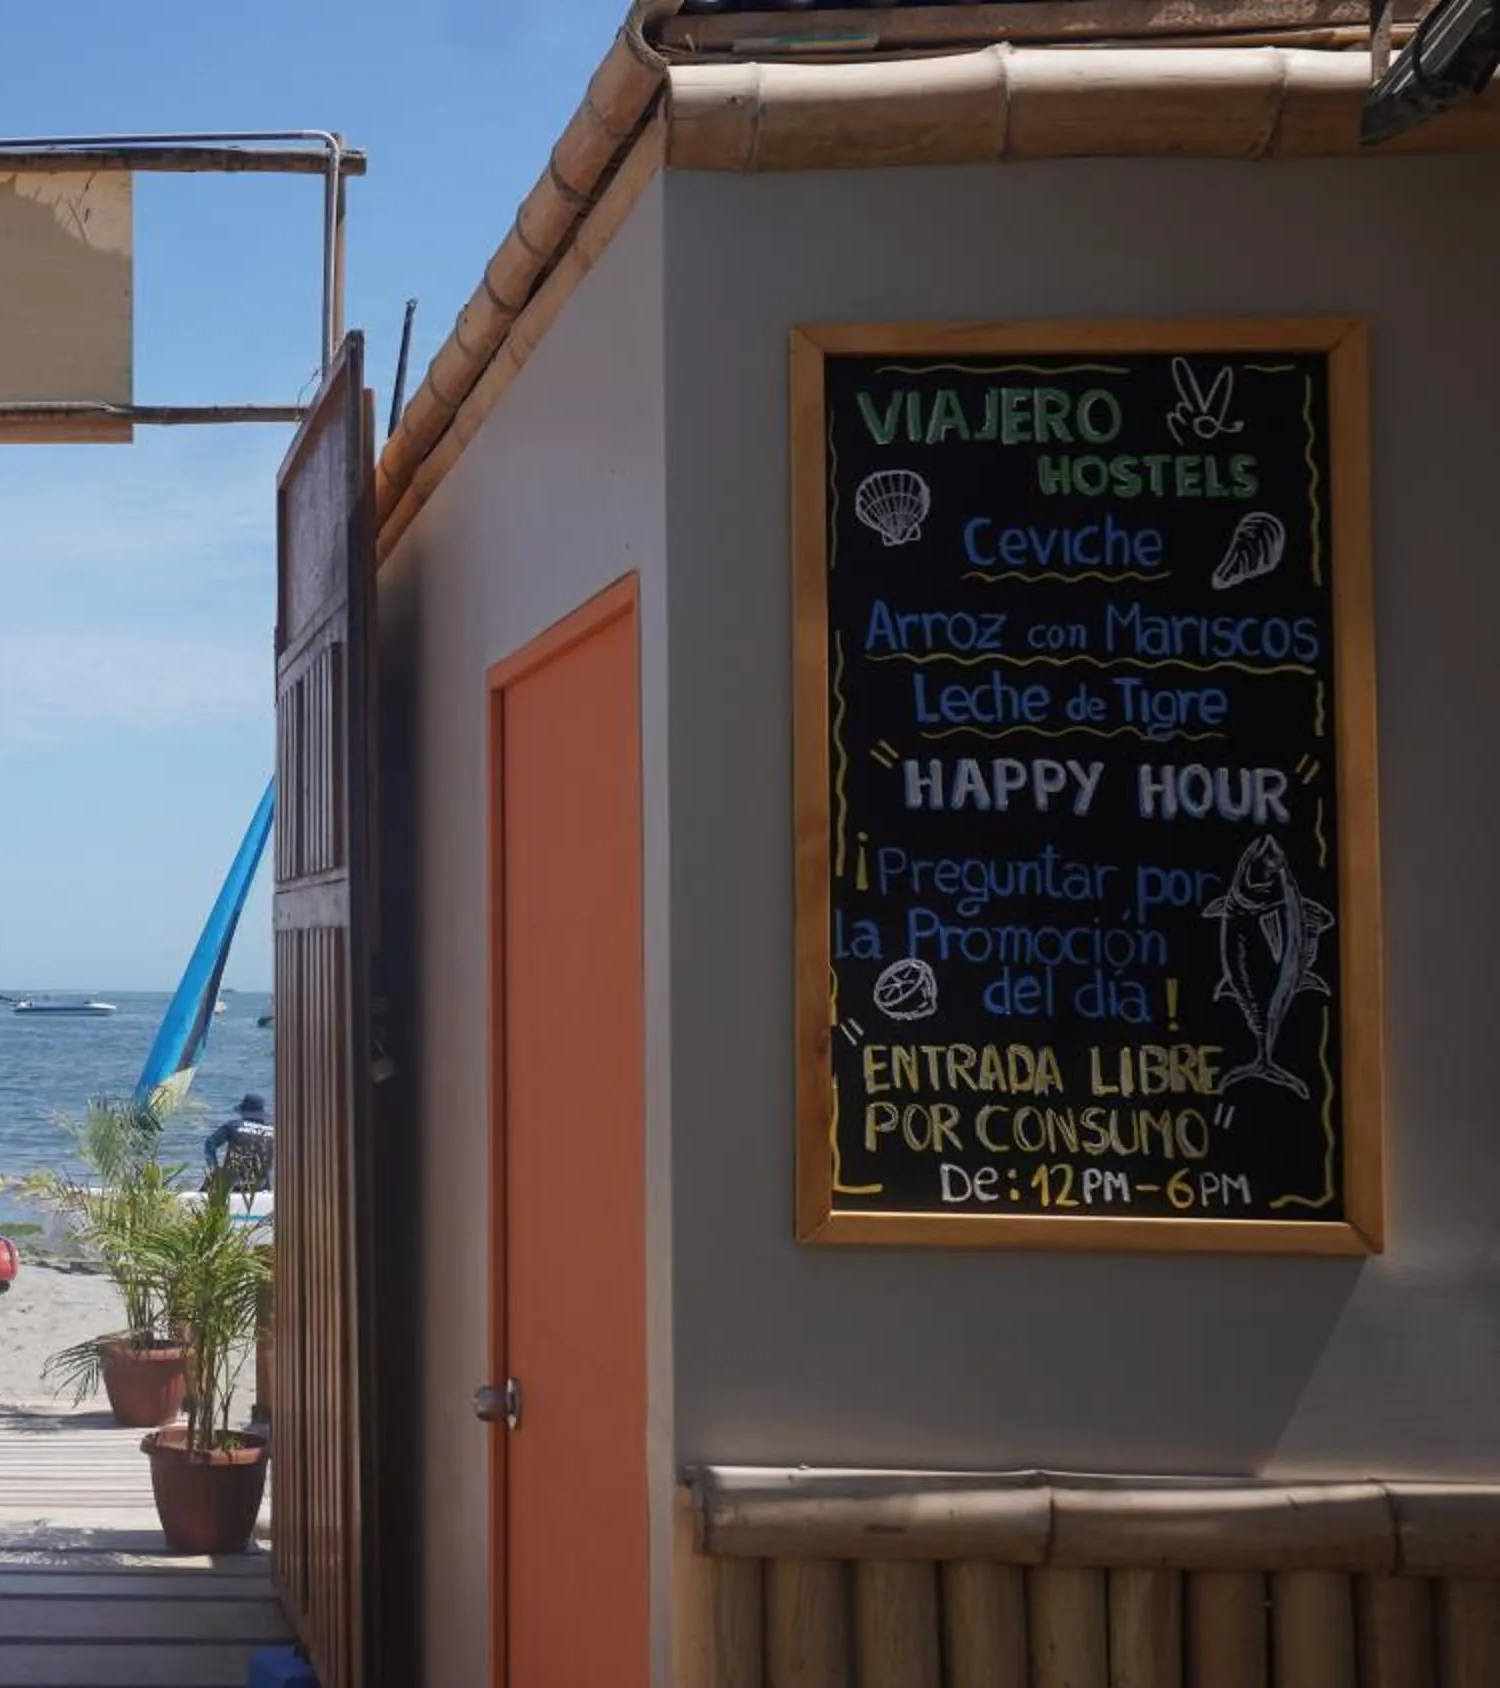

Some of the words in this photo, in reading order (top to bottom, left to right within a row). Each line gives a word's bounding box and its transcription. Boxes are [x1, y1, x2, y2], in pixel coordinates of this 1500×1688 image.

[857, 388, 1122, 444] VIAJERO
[1036, 454, 1259, 498] HOSTELS
[962, 513, 1164, 566] Ceviche
[864, 600, 1007, 650] Arroz
[1028, 620, 1087, 649] con
[1105, 602, 1320, 661] Mariscos
[913, 671, 1049, 723] Leche
[1066, 685, 1106, 721] de
[1113, 678, 1228, 742] Tigre
[1136, 861, 1221, 922] por
[834, 909, 882, 960] la
[909, 906, 1168, 966] Promoción
[982, 967, 1053, 1017] del
[1089, 1044, 1223, 1096] LIBRE
[864, 1103, 962, 1153] POR
